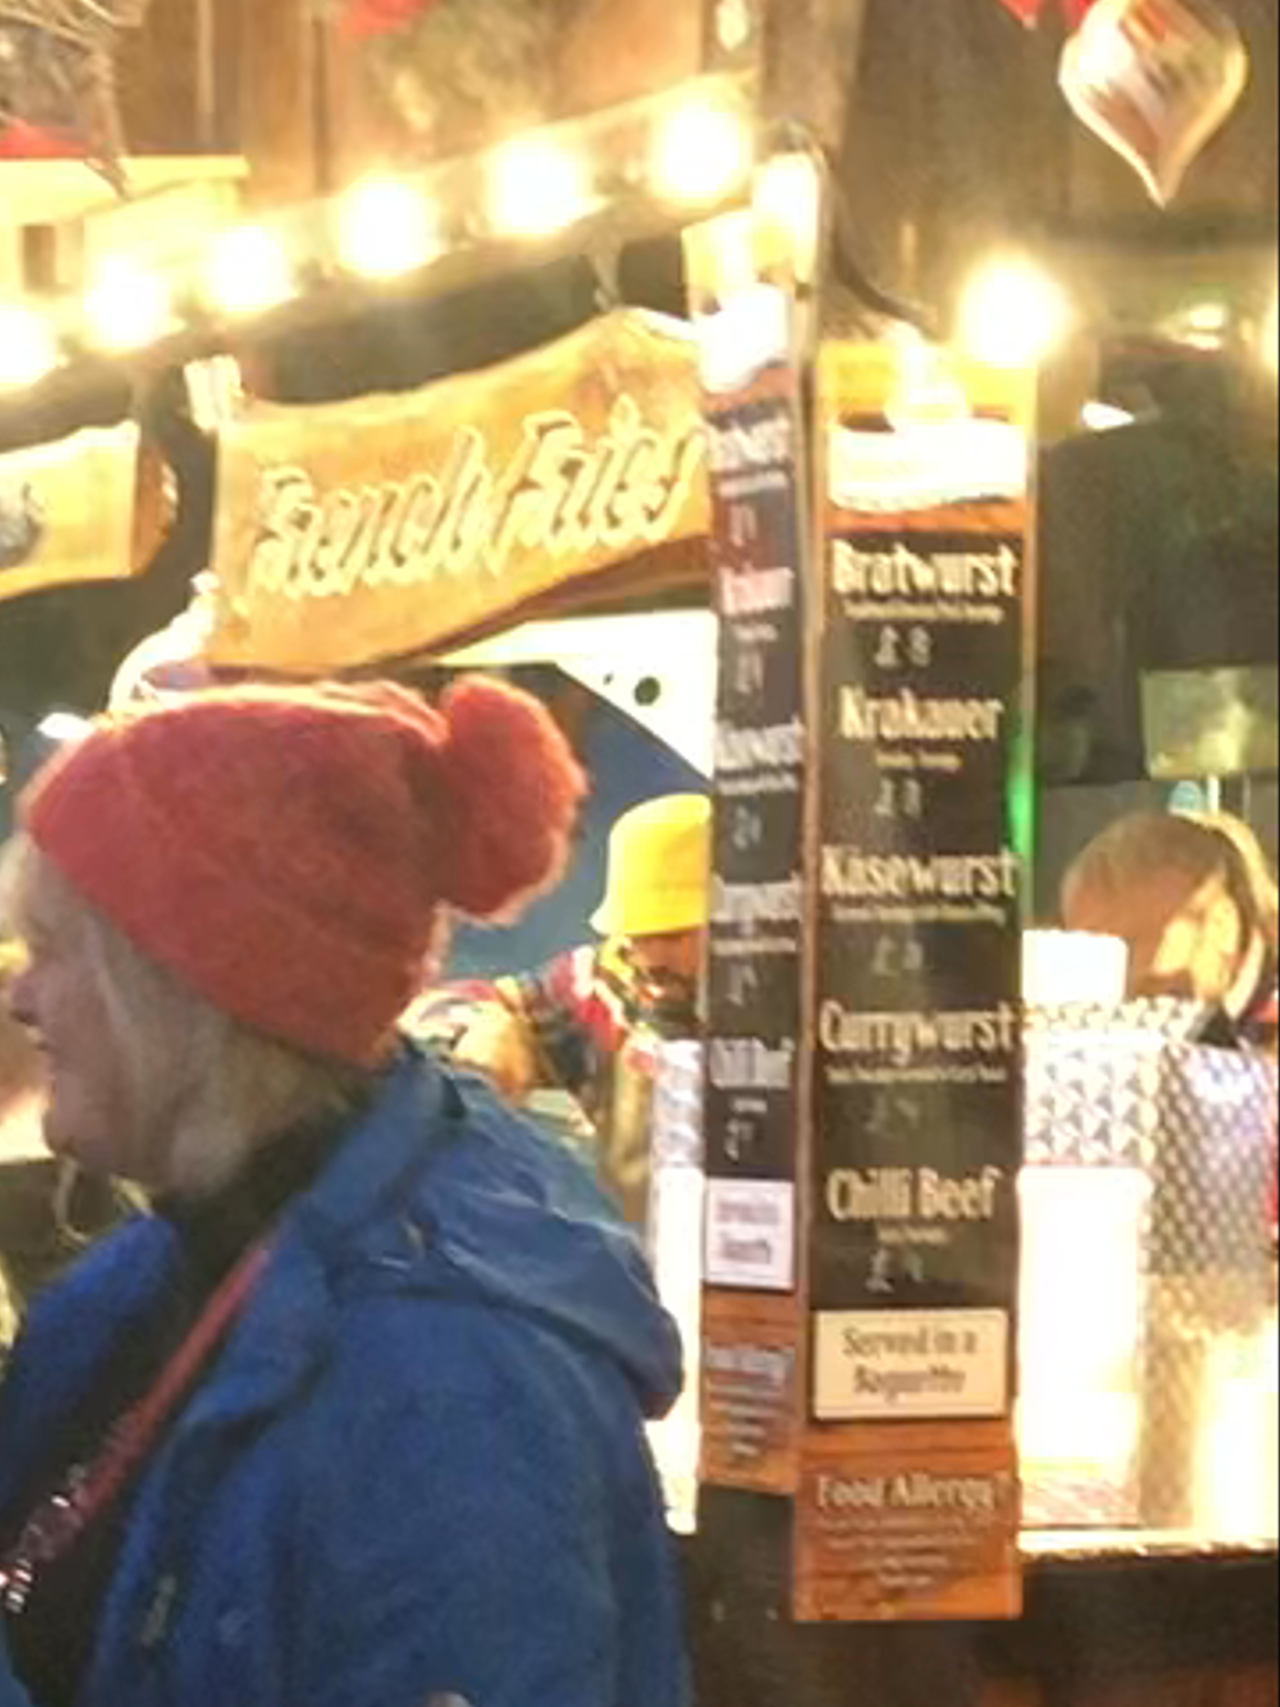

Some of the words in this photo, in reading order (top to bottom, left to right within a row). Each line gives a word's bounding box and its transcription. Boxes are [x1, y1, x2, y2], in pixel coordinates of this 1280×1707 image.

[831, 539, 1019, 597] Bratwurst
[840, 684, 1005, 740] Krakauer
[819, 999, 1016, 1066] Currywurst
[827, 1166, 913, 1221] Chilli
[918, 1163, 1003, 1219] Beef
[842, 1325, 929, 1359] Served
[818, 1474, 884, 1507] Food
